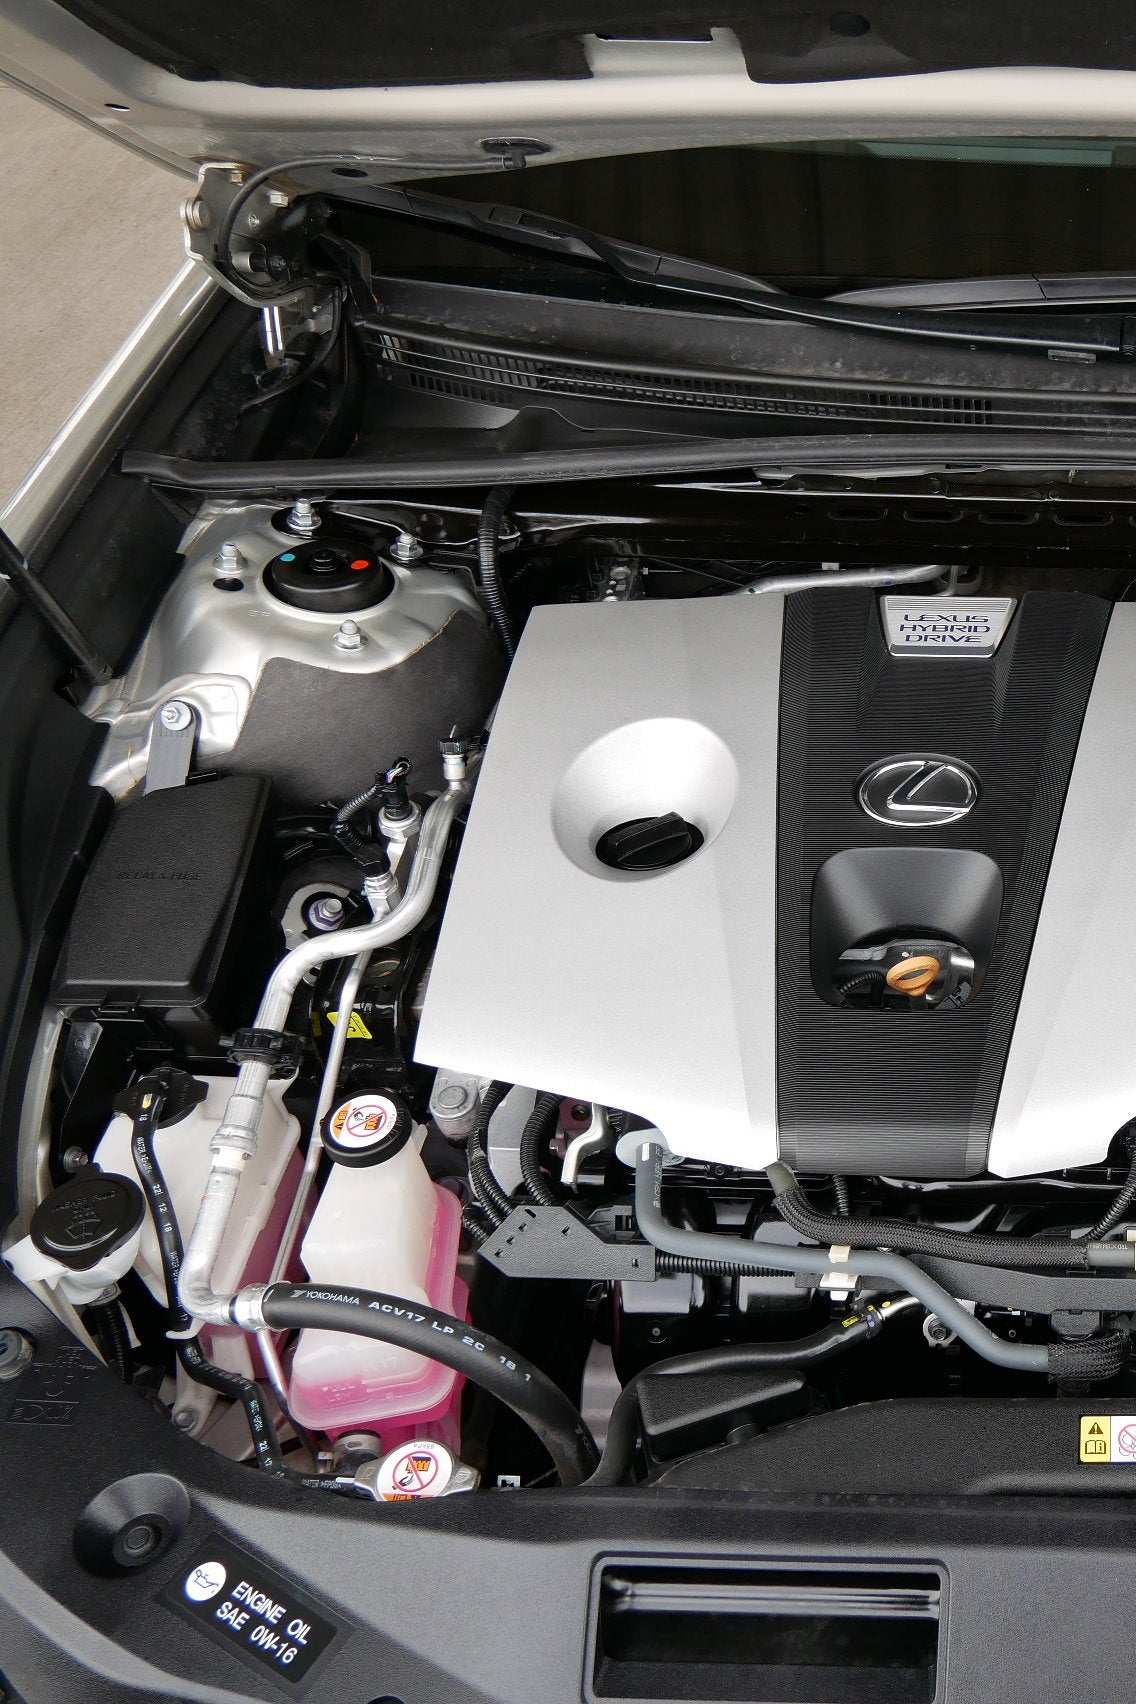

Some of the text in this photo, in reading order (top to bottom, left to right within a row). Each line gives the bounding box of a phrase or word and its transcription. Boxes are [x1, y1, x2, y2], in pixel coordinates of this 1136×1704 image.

[900, 624, 990, 632] HYBRID
[904, 614, 989, 622] LEXUS
[905, 634, 982, 642] DRIVE
[306, 1290, 360, 1305] YOKOHAMA
[368, 1301, 425, 1322] ACV17
[431, 1321, 455, 1334] LP
[462, 1335, 485, 1351] 2C
[231, 1580, 312, 1645] ENGINE OIL
[216, 1601, 298, 1664] SAE 0W-16
